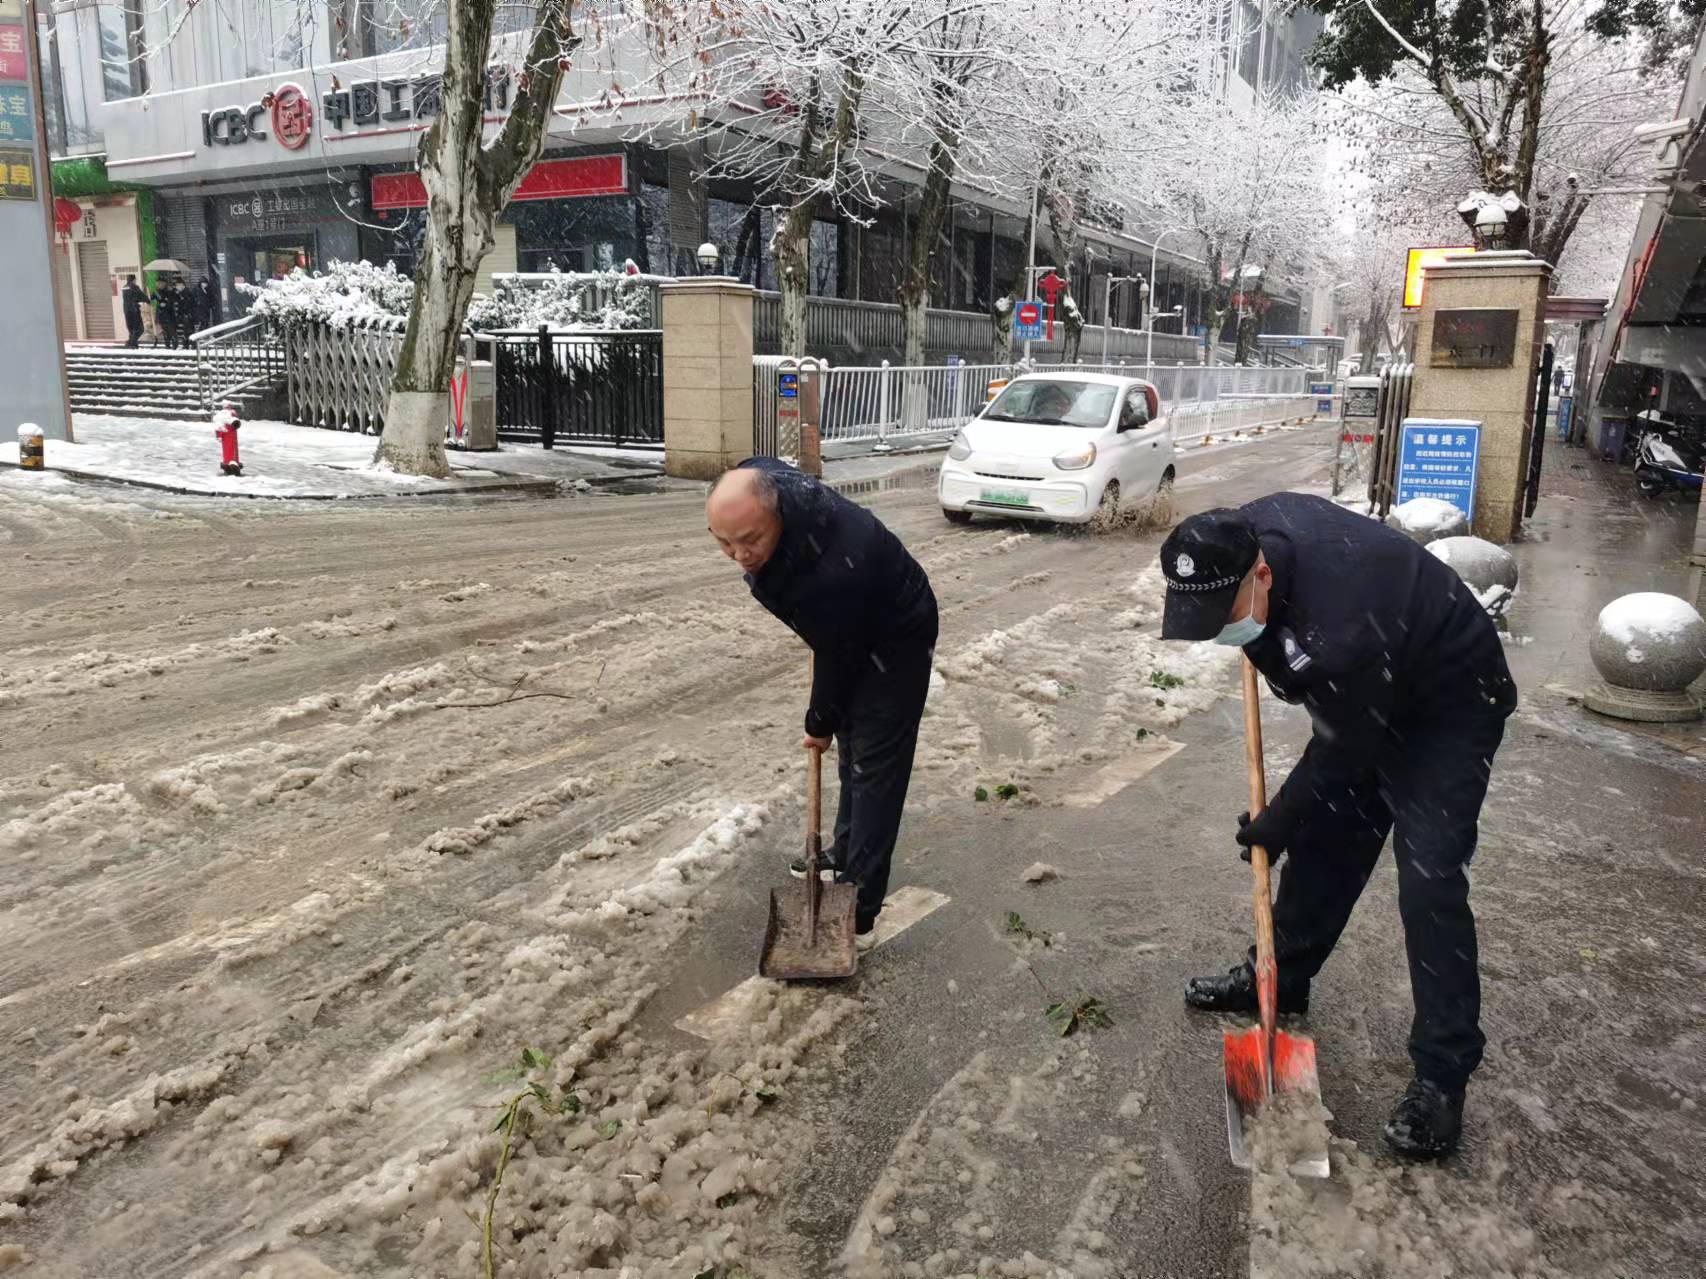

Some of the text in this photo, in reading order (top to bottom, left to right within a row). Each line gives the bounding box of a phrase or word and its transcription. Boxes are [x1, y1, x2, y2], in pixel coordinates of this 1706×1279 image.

[201, 64, 512, 147] ICBC 中国工商行
[230, 203, 250, 216] ICBC
[1412, 433, 1467, 447] 温馨提示
